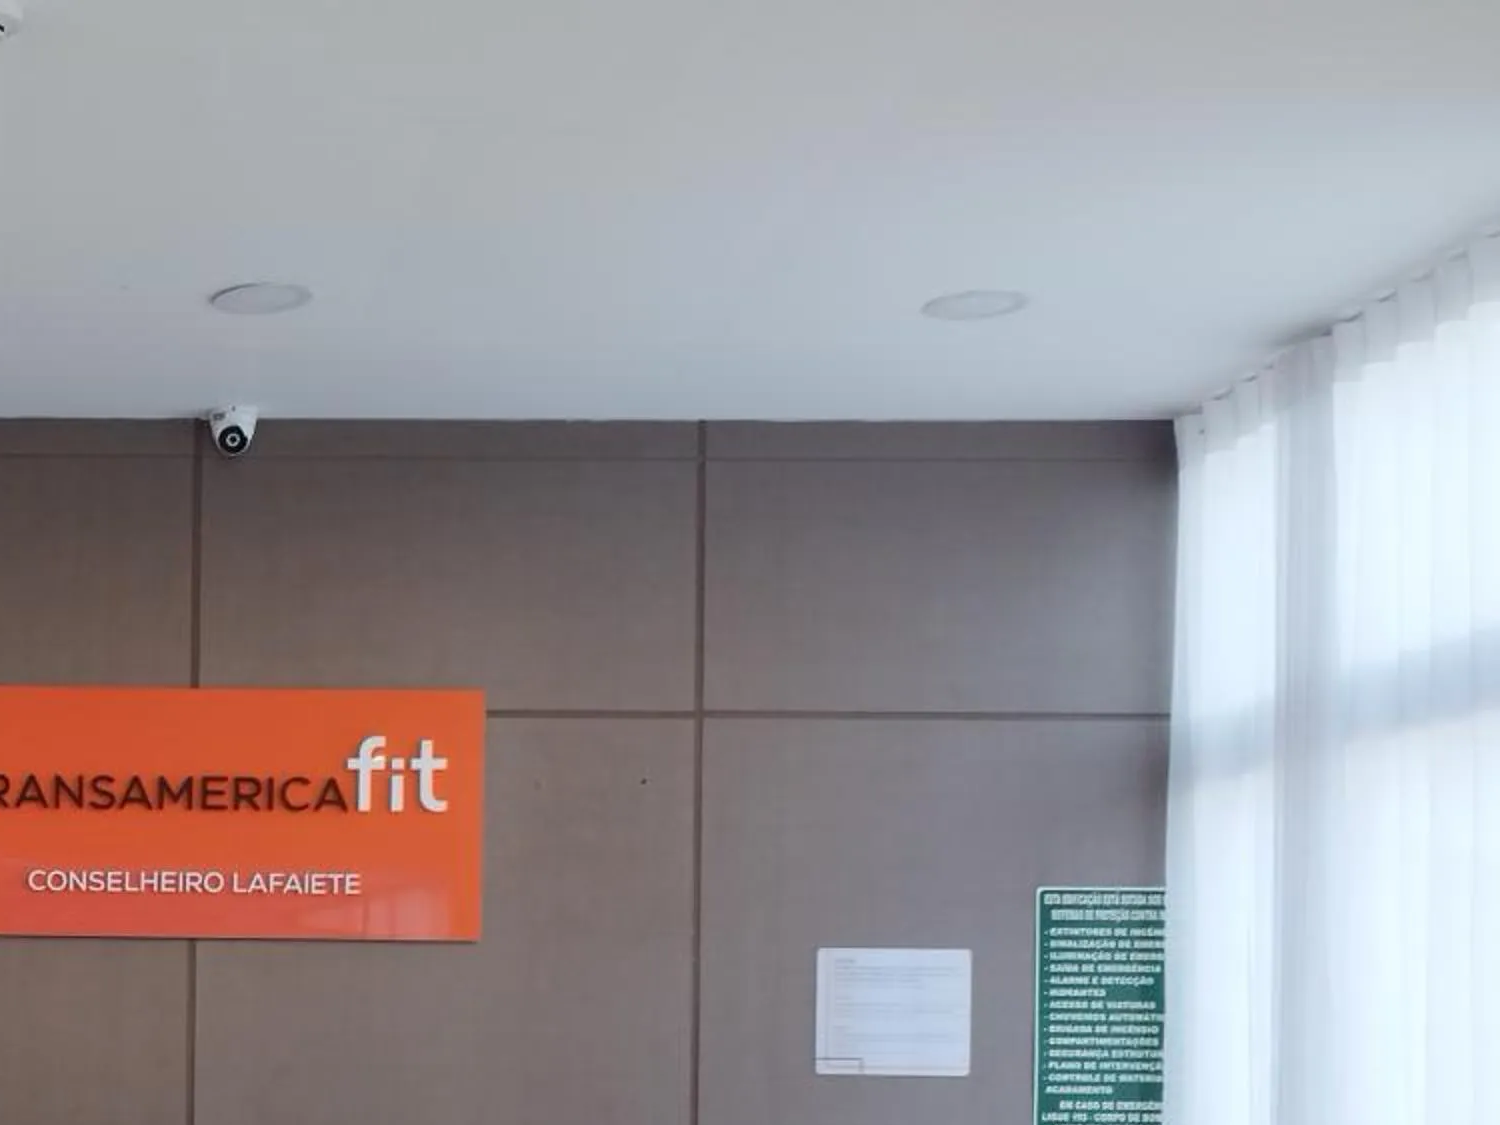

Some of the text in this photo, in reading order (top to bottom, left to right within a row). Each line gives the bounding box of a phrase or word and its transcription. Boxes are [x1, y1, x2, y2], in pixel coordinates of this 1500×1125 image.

[347, 735, 449, 813] fit
[28, 868, 362, 895] CONSELHEIRO LAFAIETE
